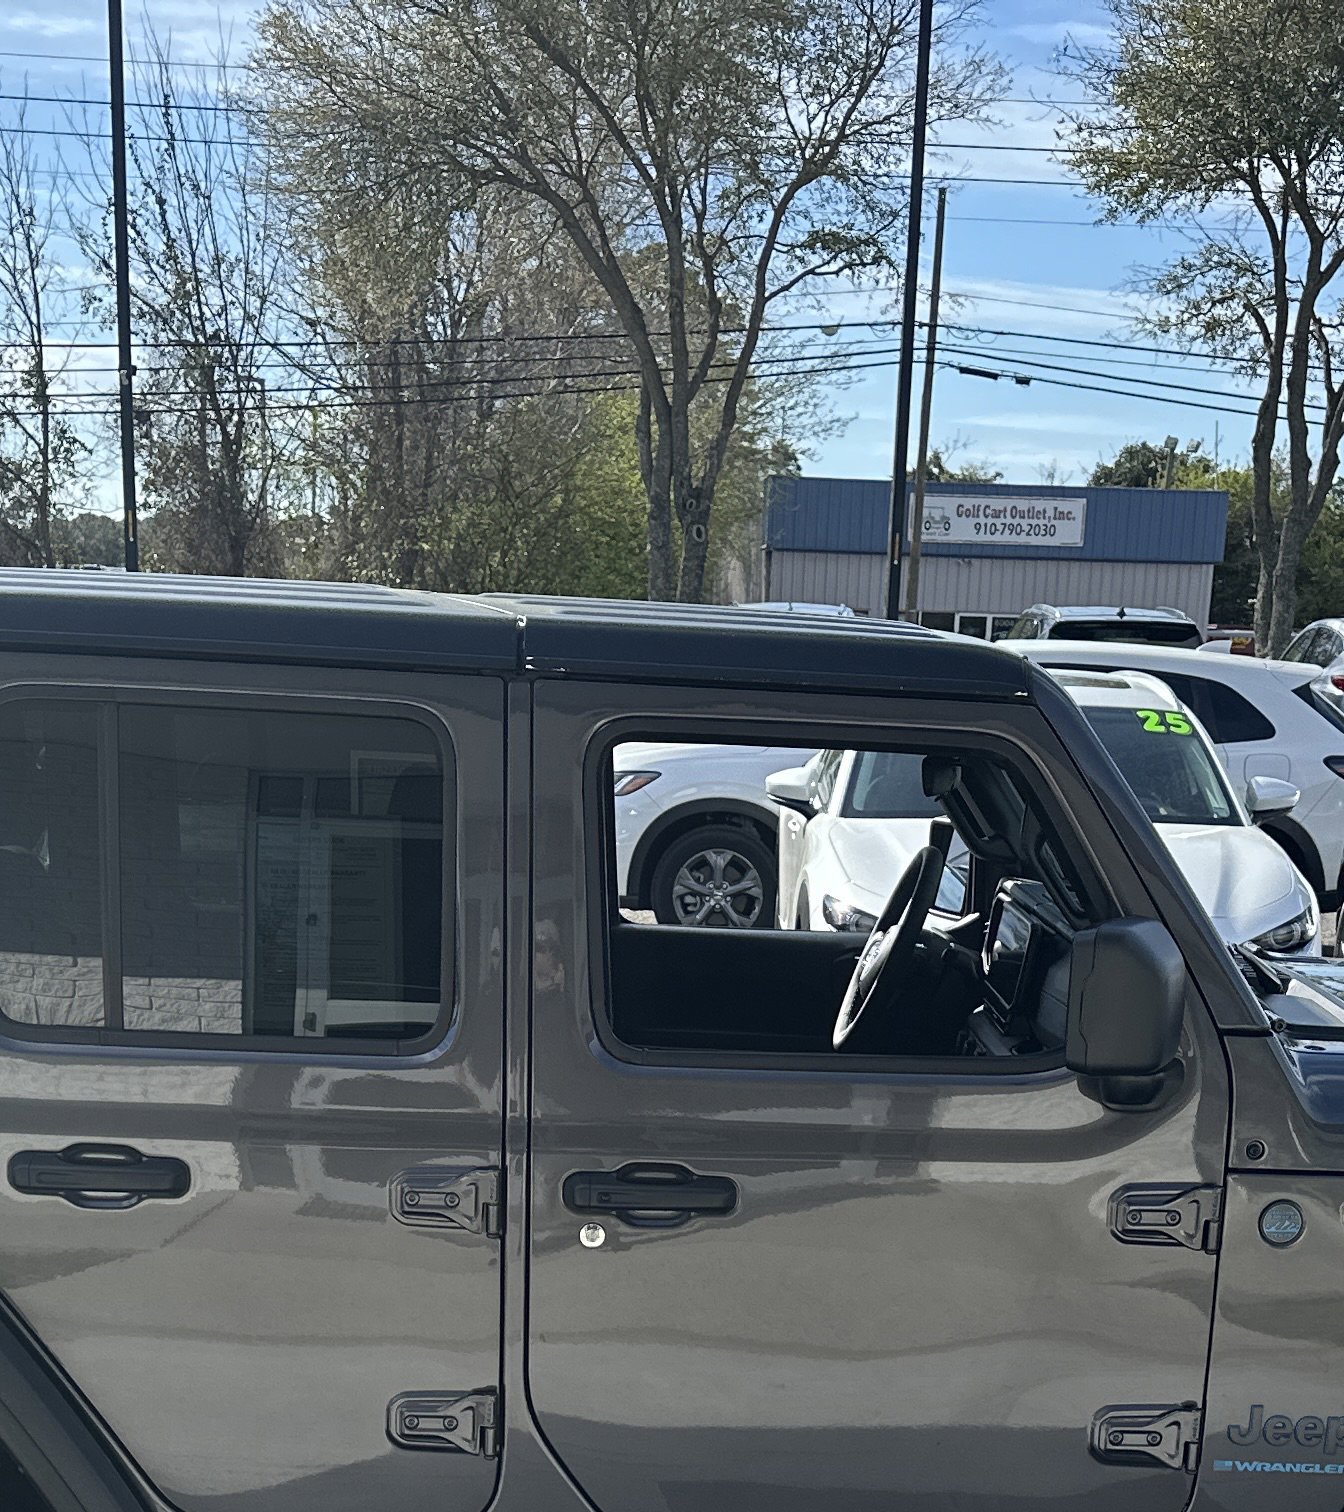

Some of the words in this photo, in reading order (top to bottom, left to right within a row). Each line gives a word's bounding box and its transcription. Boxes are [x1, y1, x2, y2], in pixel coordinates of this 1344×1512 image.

[956, 504, 982, 519] Golf
[983, 505, 1007, 520] Cart
[974, 522, 1057, 537] 910-790-2030
[1136, 709, 1193, 736] 25
